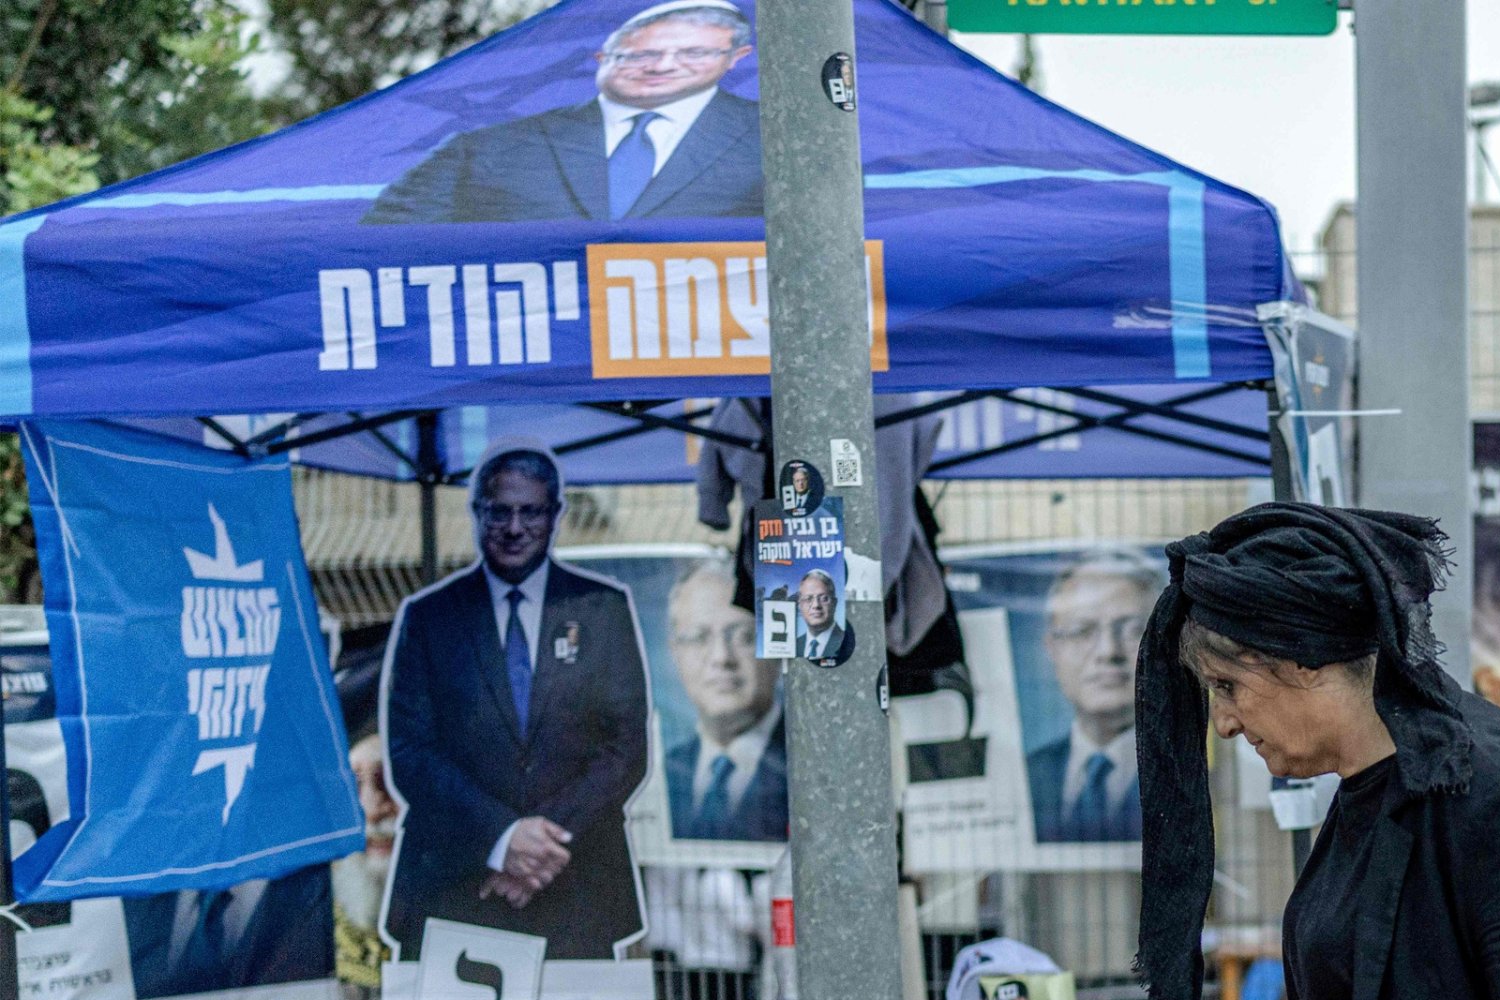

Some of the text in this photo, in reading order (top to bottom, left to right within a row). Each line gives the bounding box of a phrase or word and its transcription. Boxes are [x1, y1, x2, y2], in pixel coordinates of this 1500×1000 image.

[319, 256, 873, 371] צמה יהודית
[759, 516, 839, 540] בן גביר חזק
[759, 540, 842, 563] ישראל חזקה!
[771, 608, 787, 643] ב
